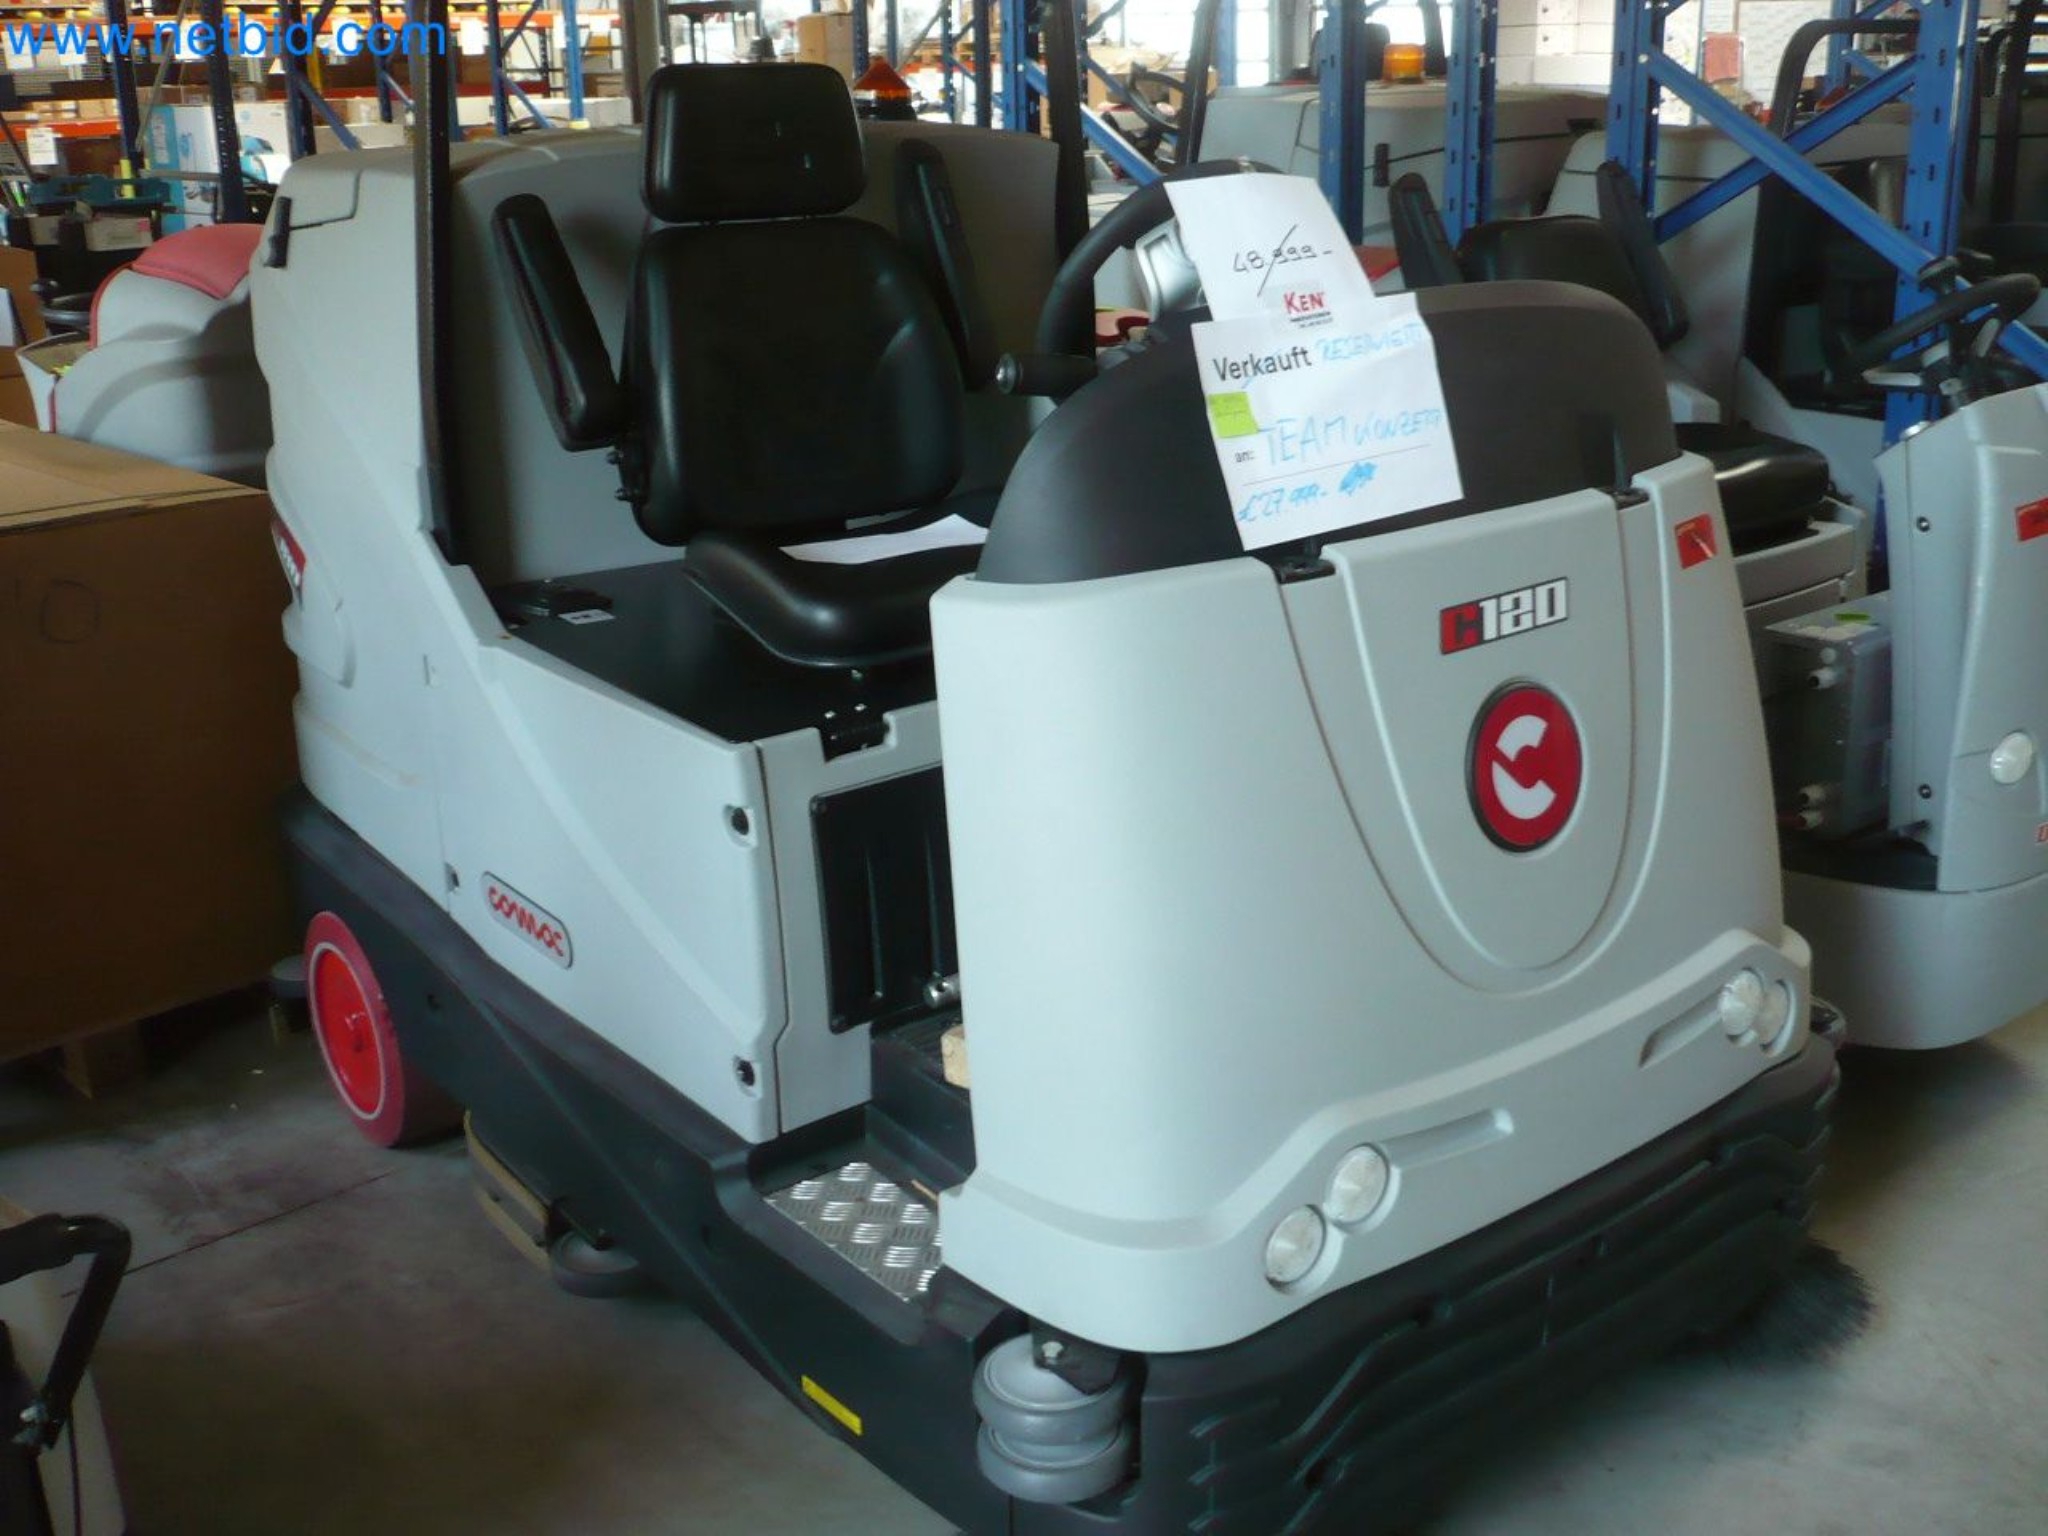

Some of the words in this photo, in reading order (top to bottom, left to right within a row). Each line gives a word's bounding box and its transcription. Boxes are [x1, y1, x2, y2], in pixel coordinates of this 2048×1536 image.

[1283, 291, 1326, 314] KEN
[1213, 345, 1312, 382] Verkauft
[1258, 415, 1346, 467] TEAM
[1440, 577, 1568, 655] C120
